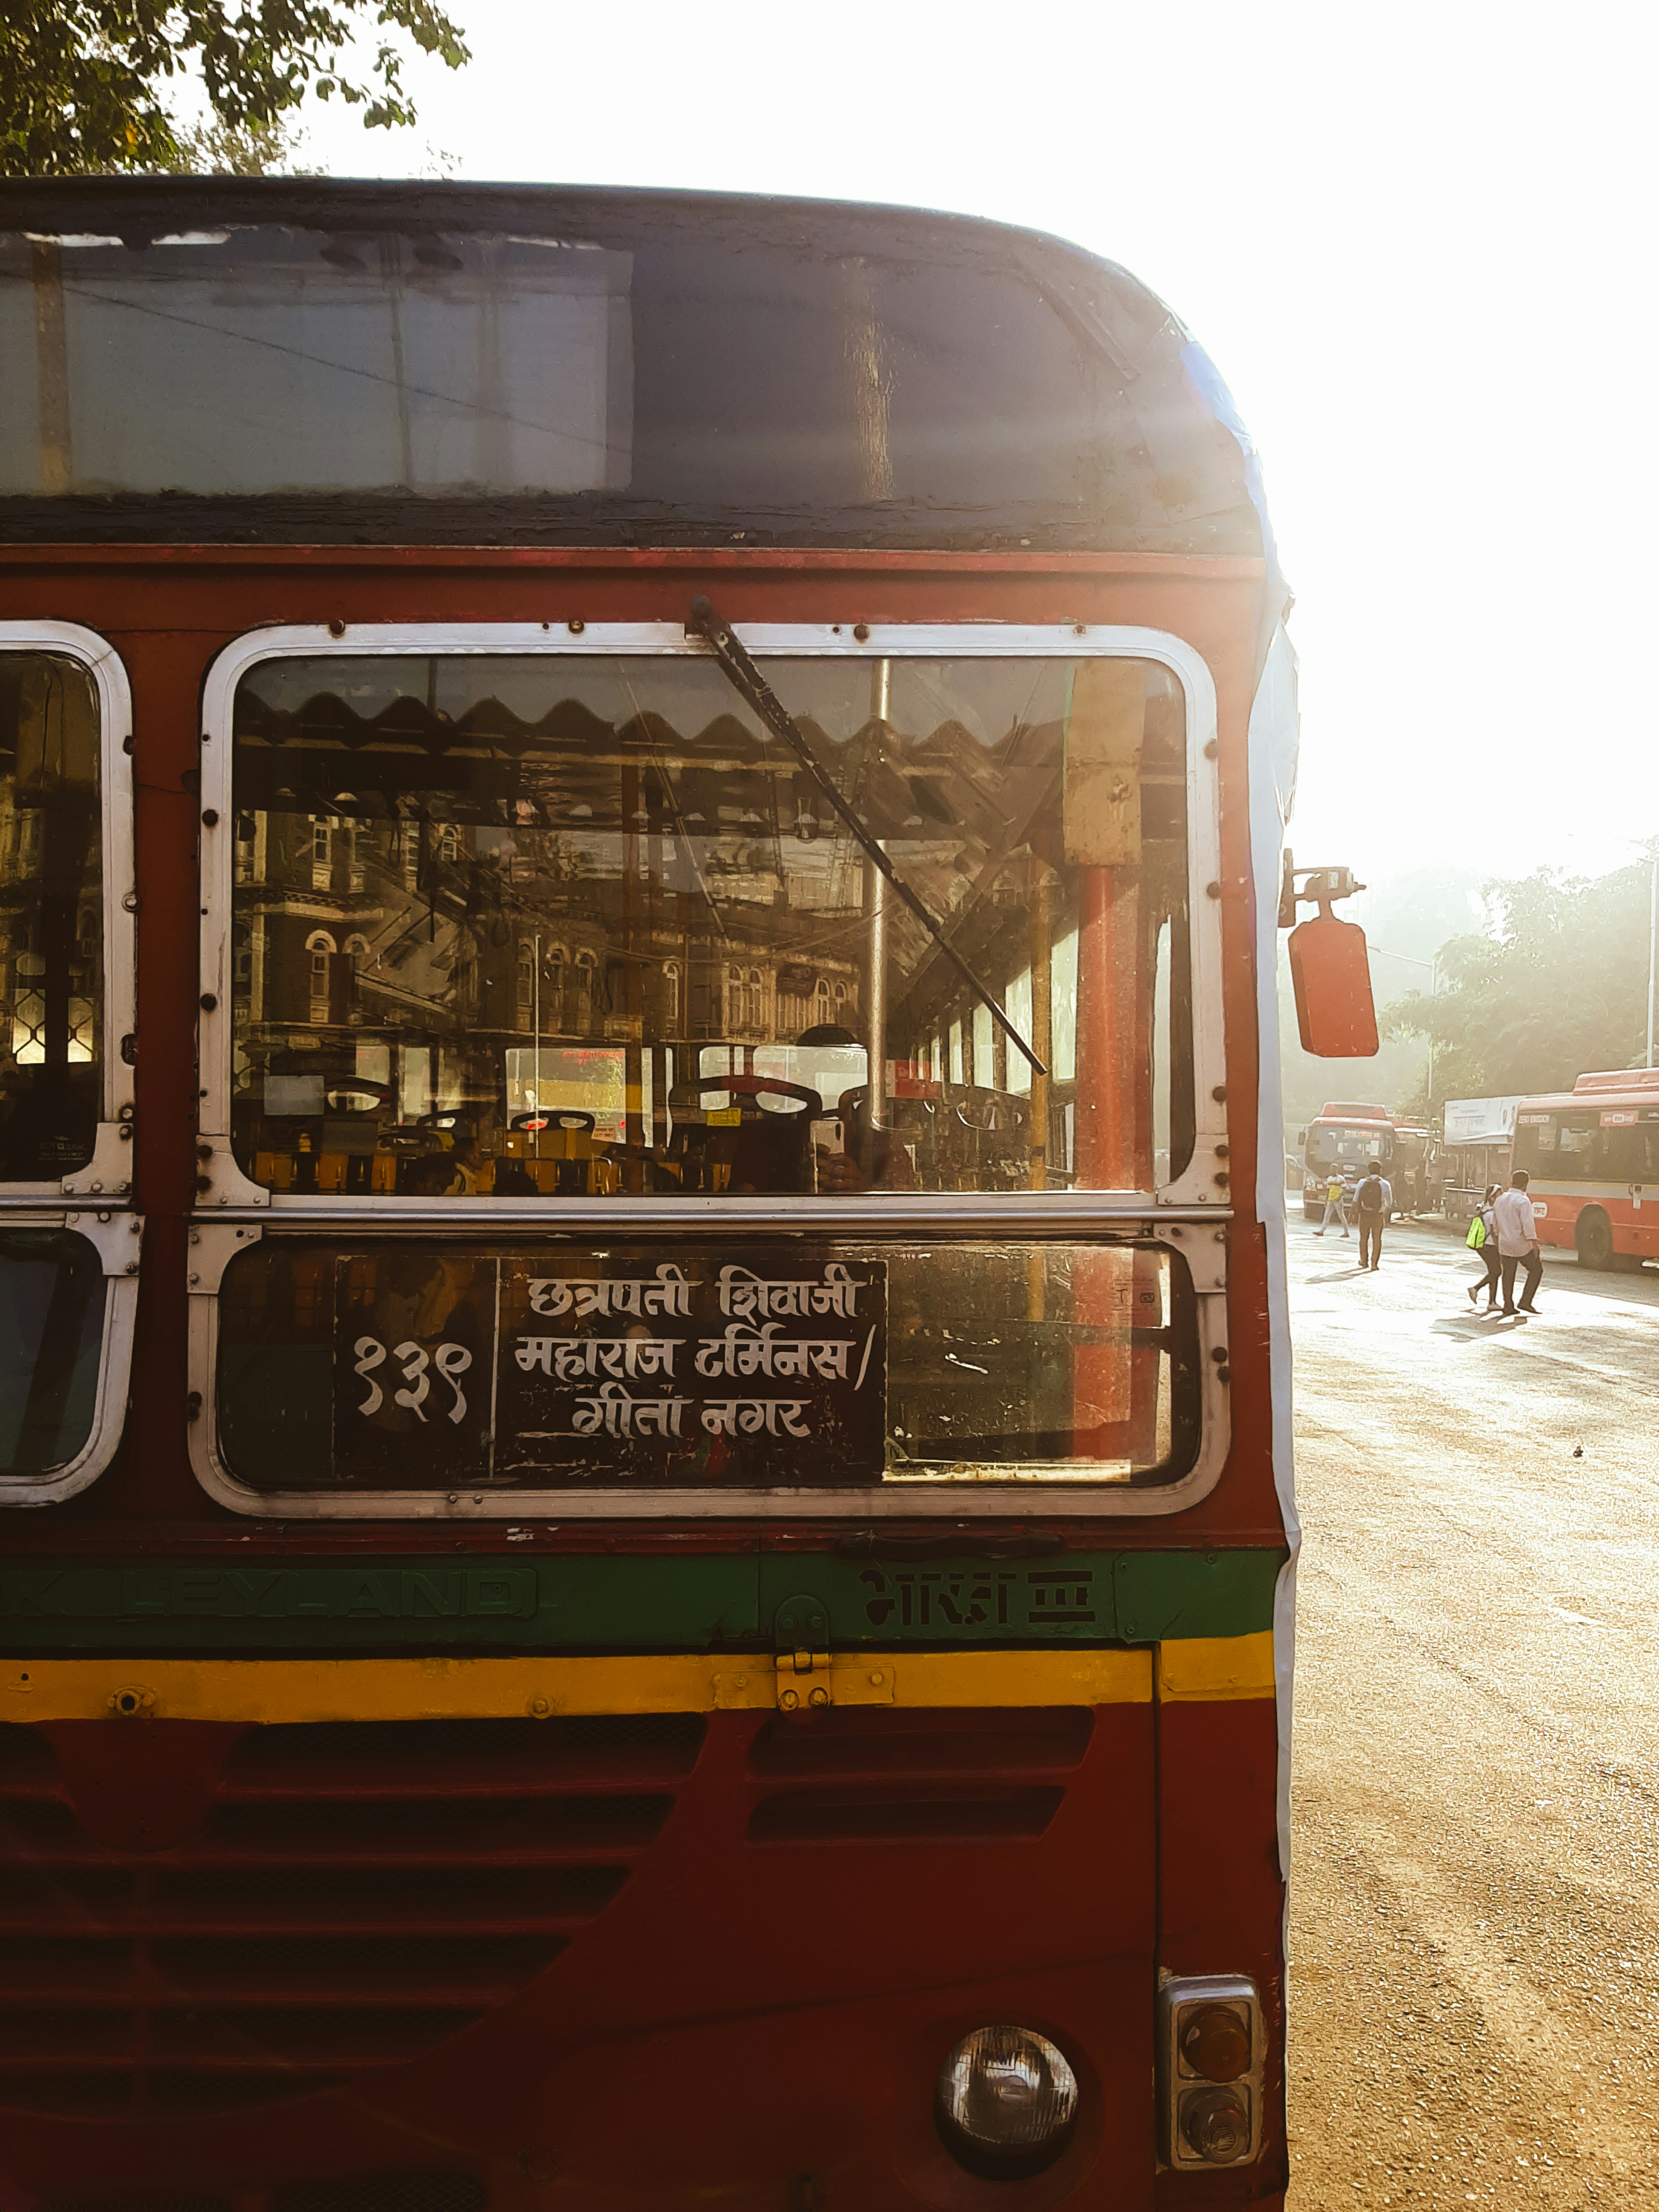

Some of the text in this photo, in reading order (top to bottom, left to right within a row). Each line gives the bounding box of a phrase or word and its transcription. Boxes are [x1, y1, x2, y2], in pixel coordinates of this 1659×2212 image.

[527, 1263, 868, 1326] छत्रपती शिवाजी
[354, 1336, 472, 1424] १३९
[514, 1336, 687, 1382] महाराज
[572, 1381, 812, 1439] गीता नगर
[121, 1569, 536, 1617] LEYLAND
